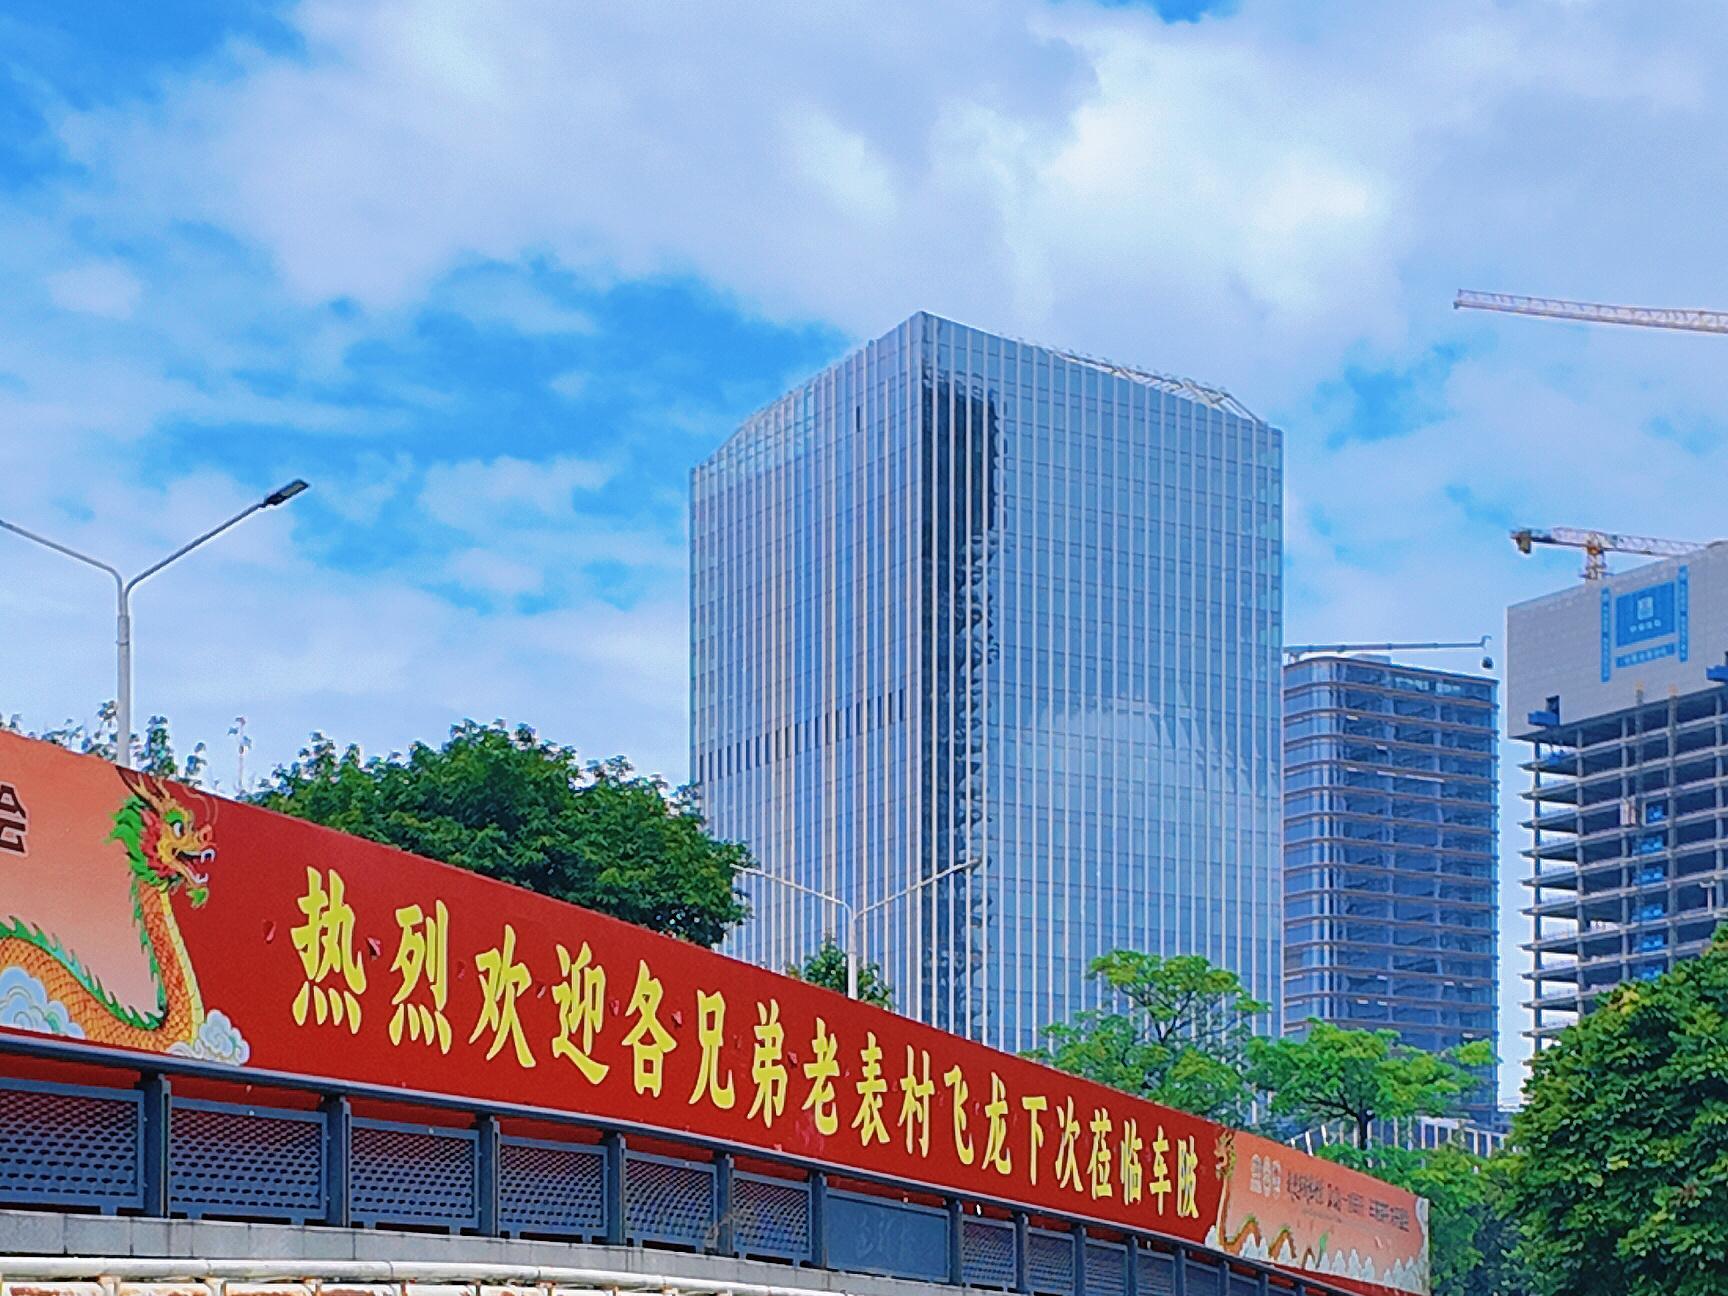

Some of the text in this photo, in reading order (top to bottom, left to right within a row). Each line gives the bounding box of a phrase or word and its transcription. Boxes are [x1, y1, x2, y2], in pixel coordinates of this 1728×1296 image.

[291, 866, 1199, 1219] 热烈欢迎各兄弟老表村飞龙下次莅临车陂
